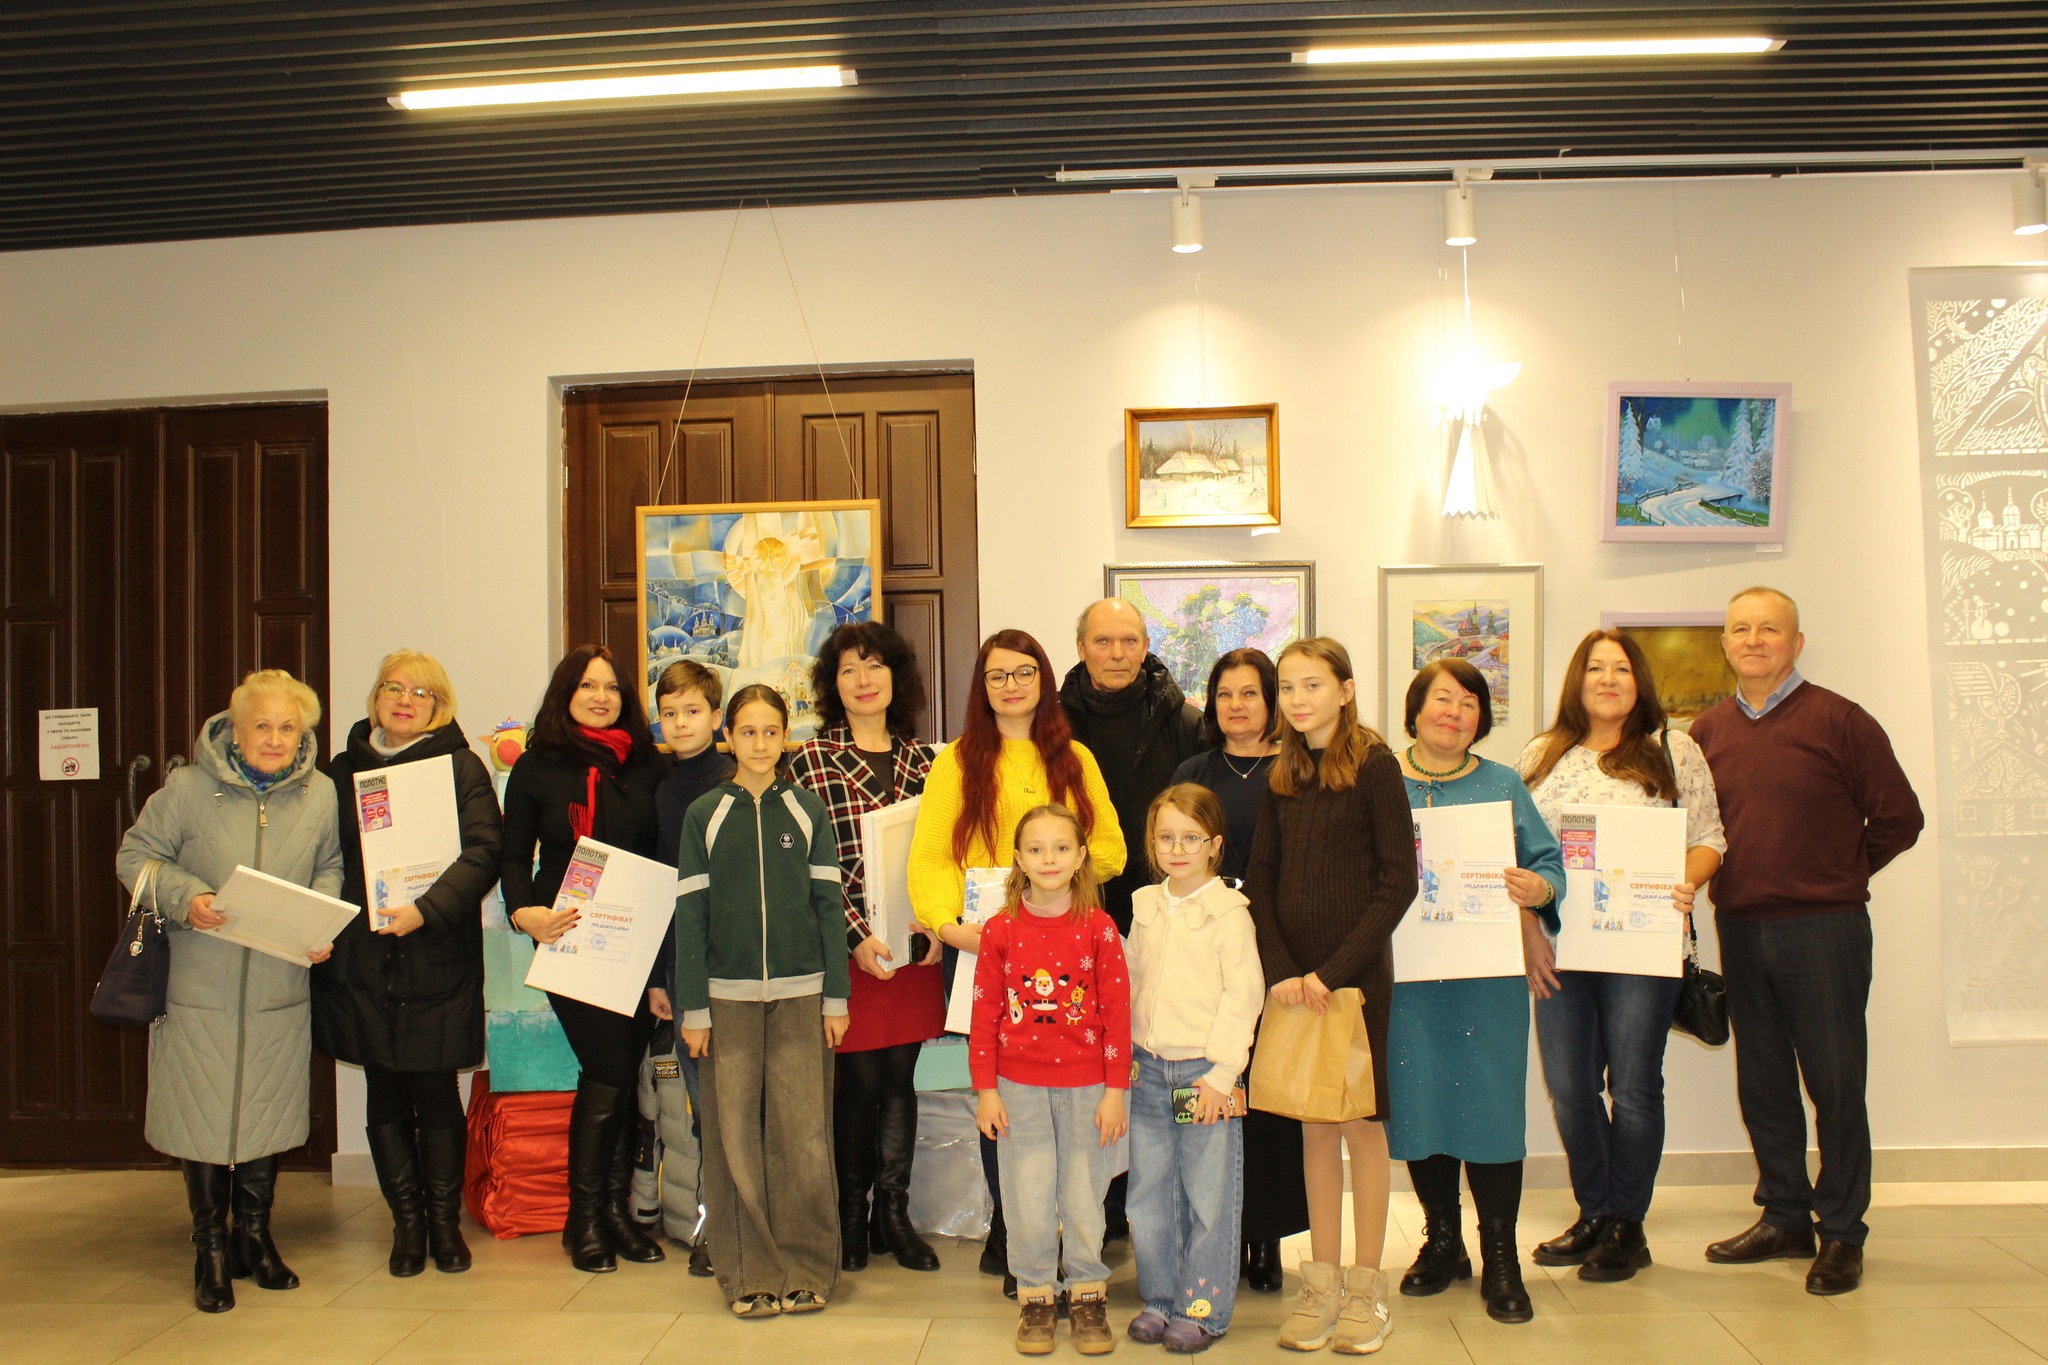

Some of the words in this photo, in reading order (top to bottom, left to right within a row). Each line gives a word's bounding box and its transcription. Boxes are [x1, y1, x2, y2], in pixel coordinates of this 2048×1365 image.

[360, 777, 386, 787] ПОЛОТНО
[1562, 815, 1595, 824] ПОЛОТНО
[577, 846, 608, 861] ПОЛОТНО
[404, 871, 439, 882] СЕРТИФІКАТ
[590, 912, 633, 923] СЕРТИФІКАТ
